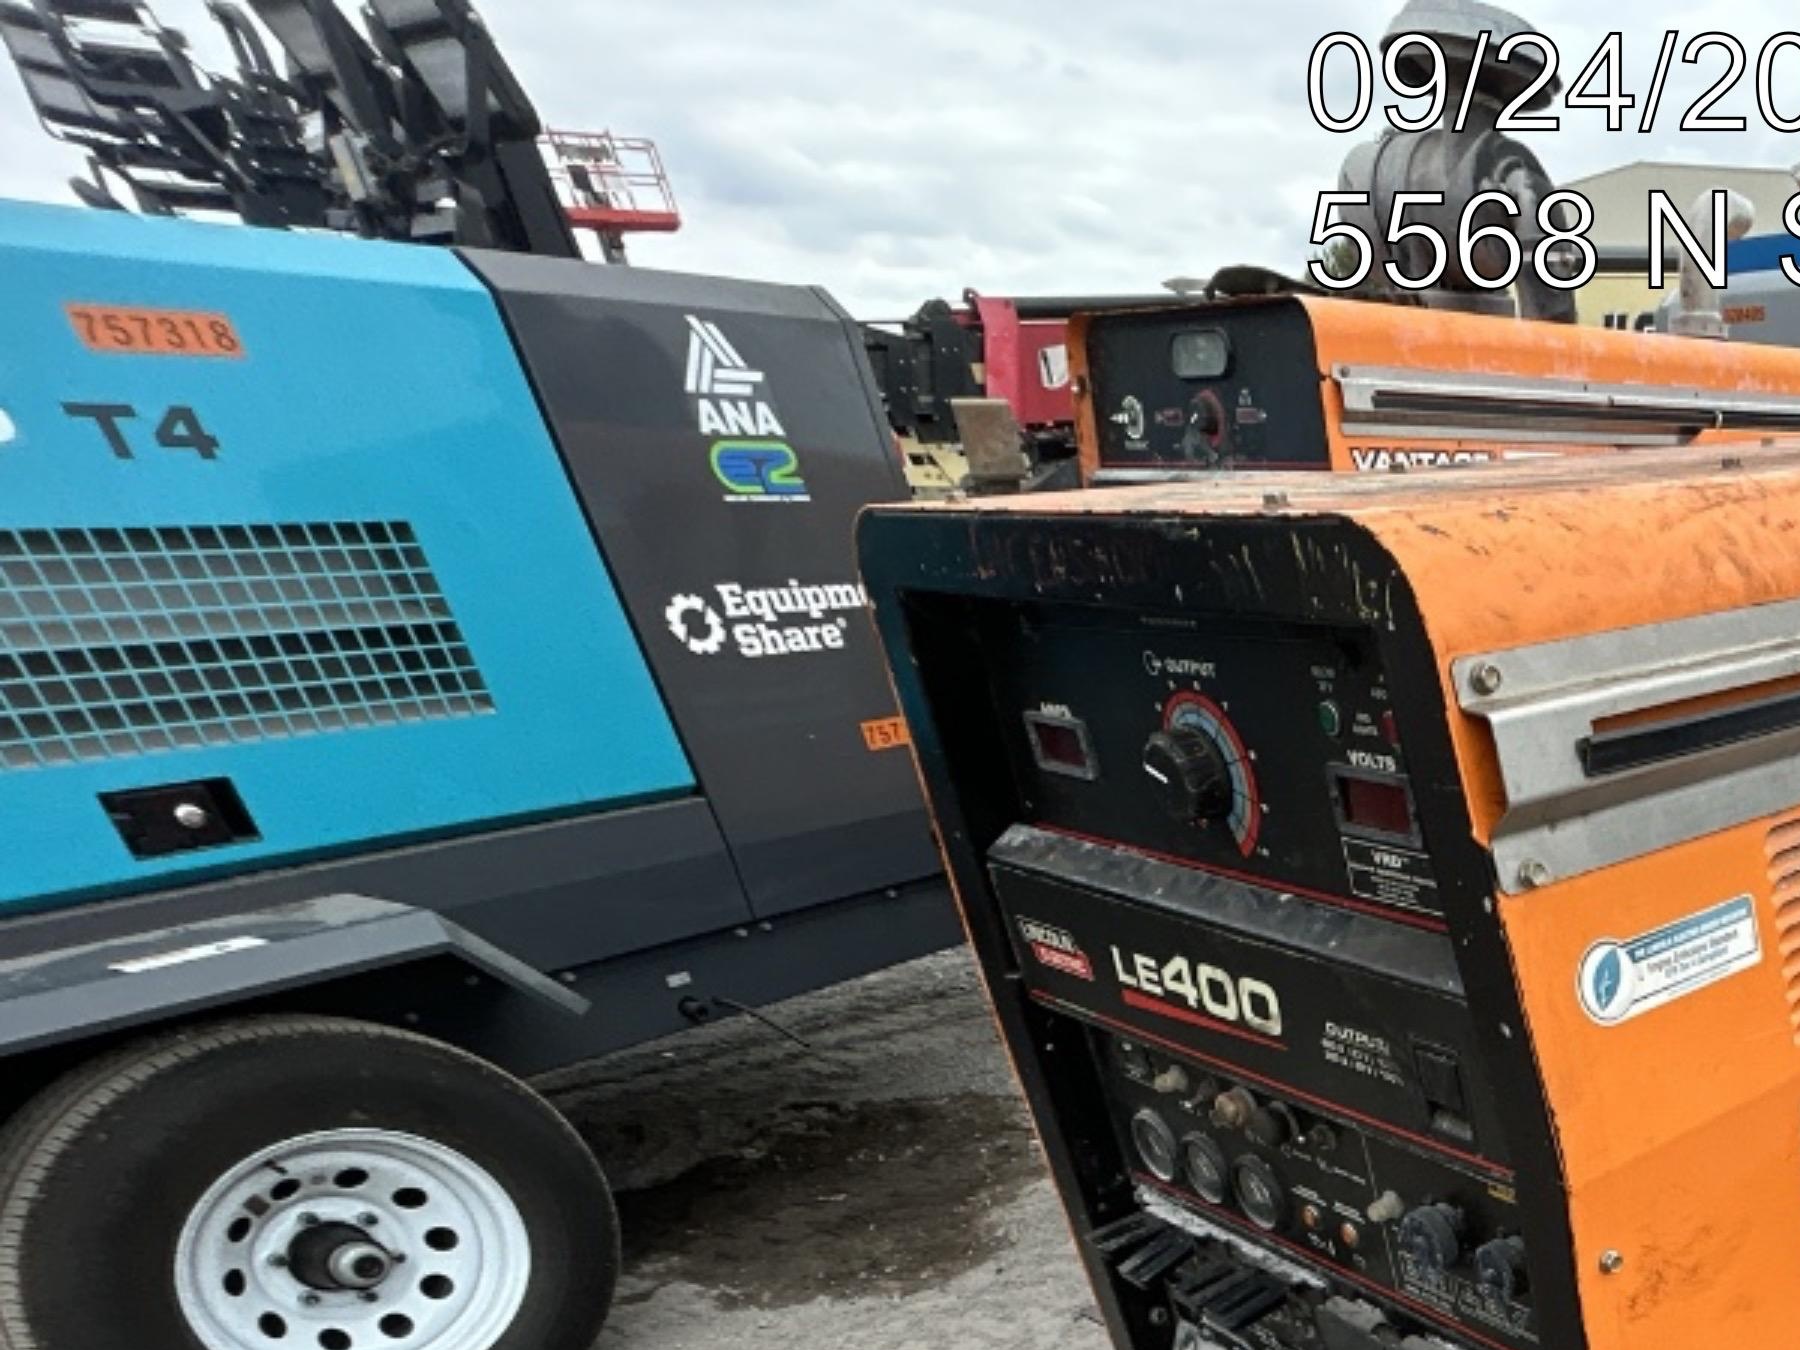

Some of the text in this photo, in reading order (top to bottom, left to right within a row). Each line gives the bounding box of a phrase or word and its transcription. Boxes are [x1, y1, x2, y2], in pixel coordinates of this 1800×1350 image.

[69, 312, 238, 351] 757318
[698, 399, 787, 436] ANA
[1110, 944, 1283, 1037] LE400
